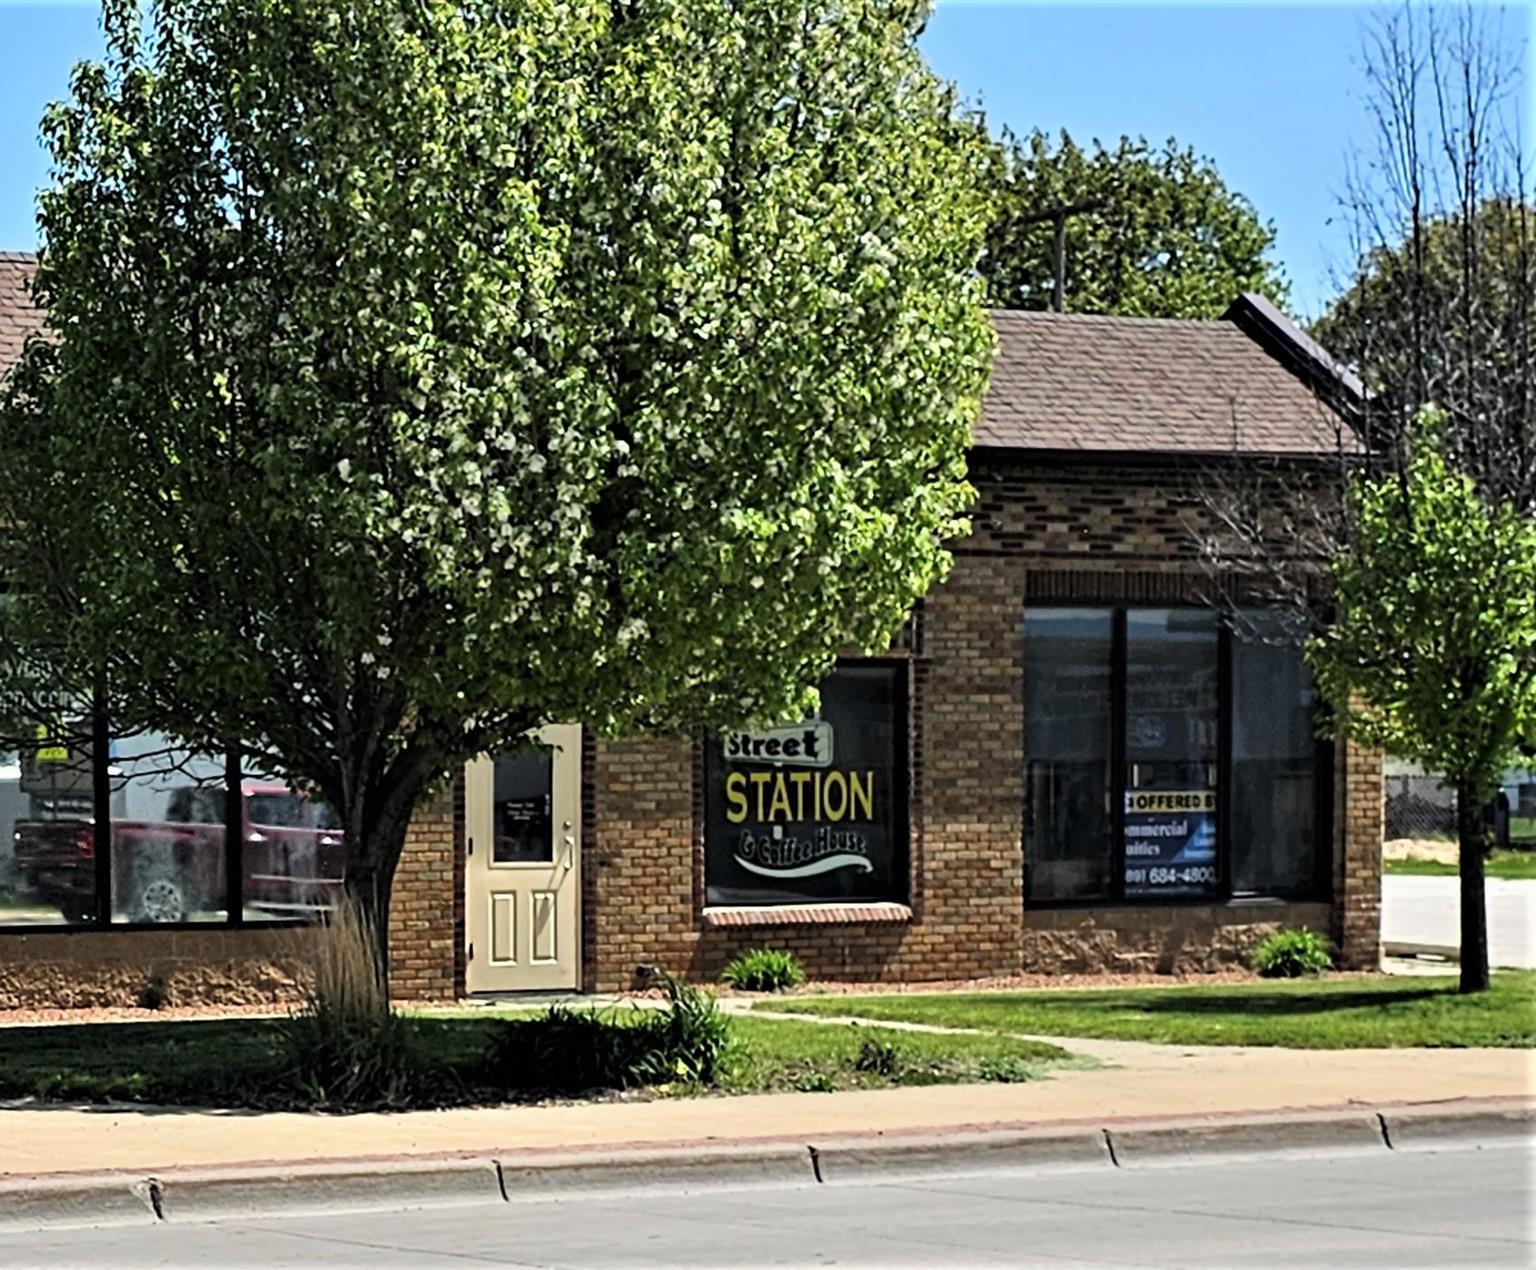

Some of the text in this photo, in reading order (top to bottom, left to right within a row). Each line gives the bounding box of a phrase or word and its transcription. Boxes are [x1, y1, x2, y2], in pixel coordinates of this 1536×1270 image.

[728, 730, 819, 759] Street
[726, 771, 874, 823] STATION
[1136, 795, 1214, 810] OFFERED B
[1125, 820, 1187, 837] mmercial
[739, 826, 867, 866] & Coffee House
[1149, 867, 1215, 884] 684-4800
